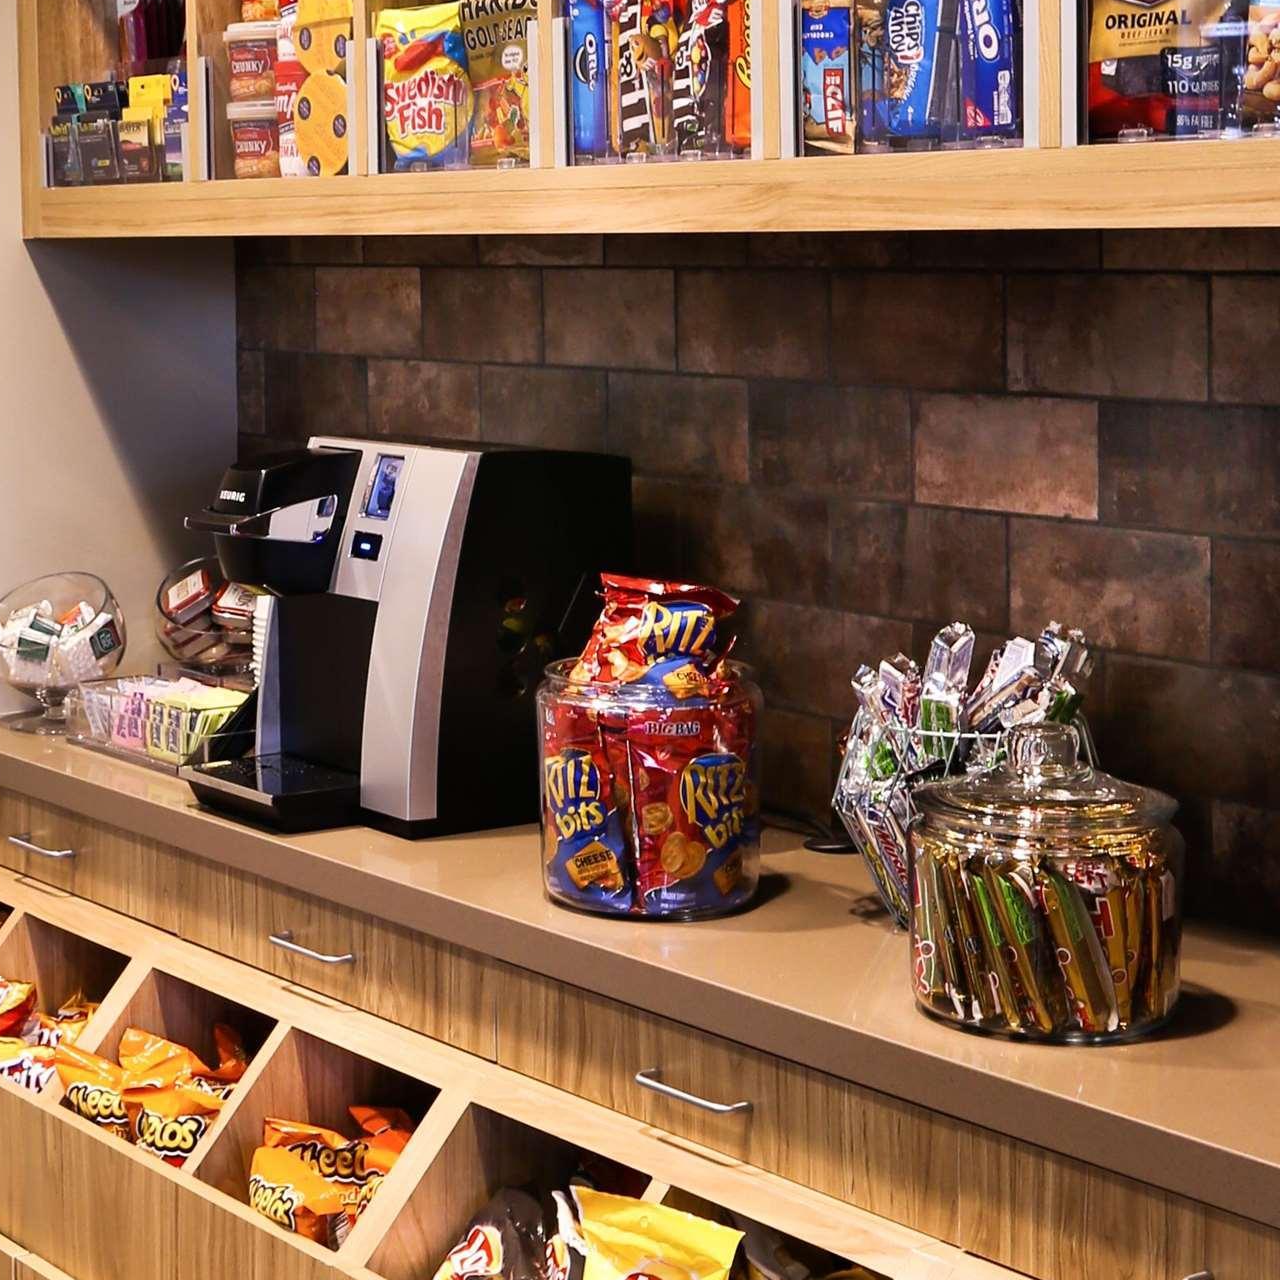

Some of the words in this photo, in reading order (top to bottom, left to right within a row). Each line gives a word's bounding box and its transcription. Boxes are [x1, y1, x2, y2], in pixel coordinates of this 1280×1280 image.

[1105, 8, 1193, 31] ORIGINAL
[1166, 53, 1193, 70] 15g
[397, 101, 443, 134] Fish
[639, 601, 716, 654] RITZ
[556, 801, 604, 839] bits
[575, 850, 613, 869] CHEESE
